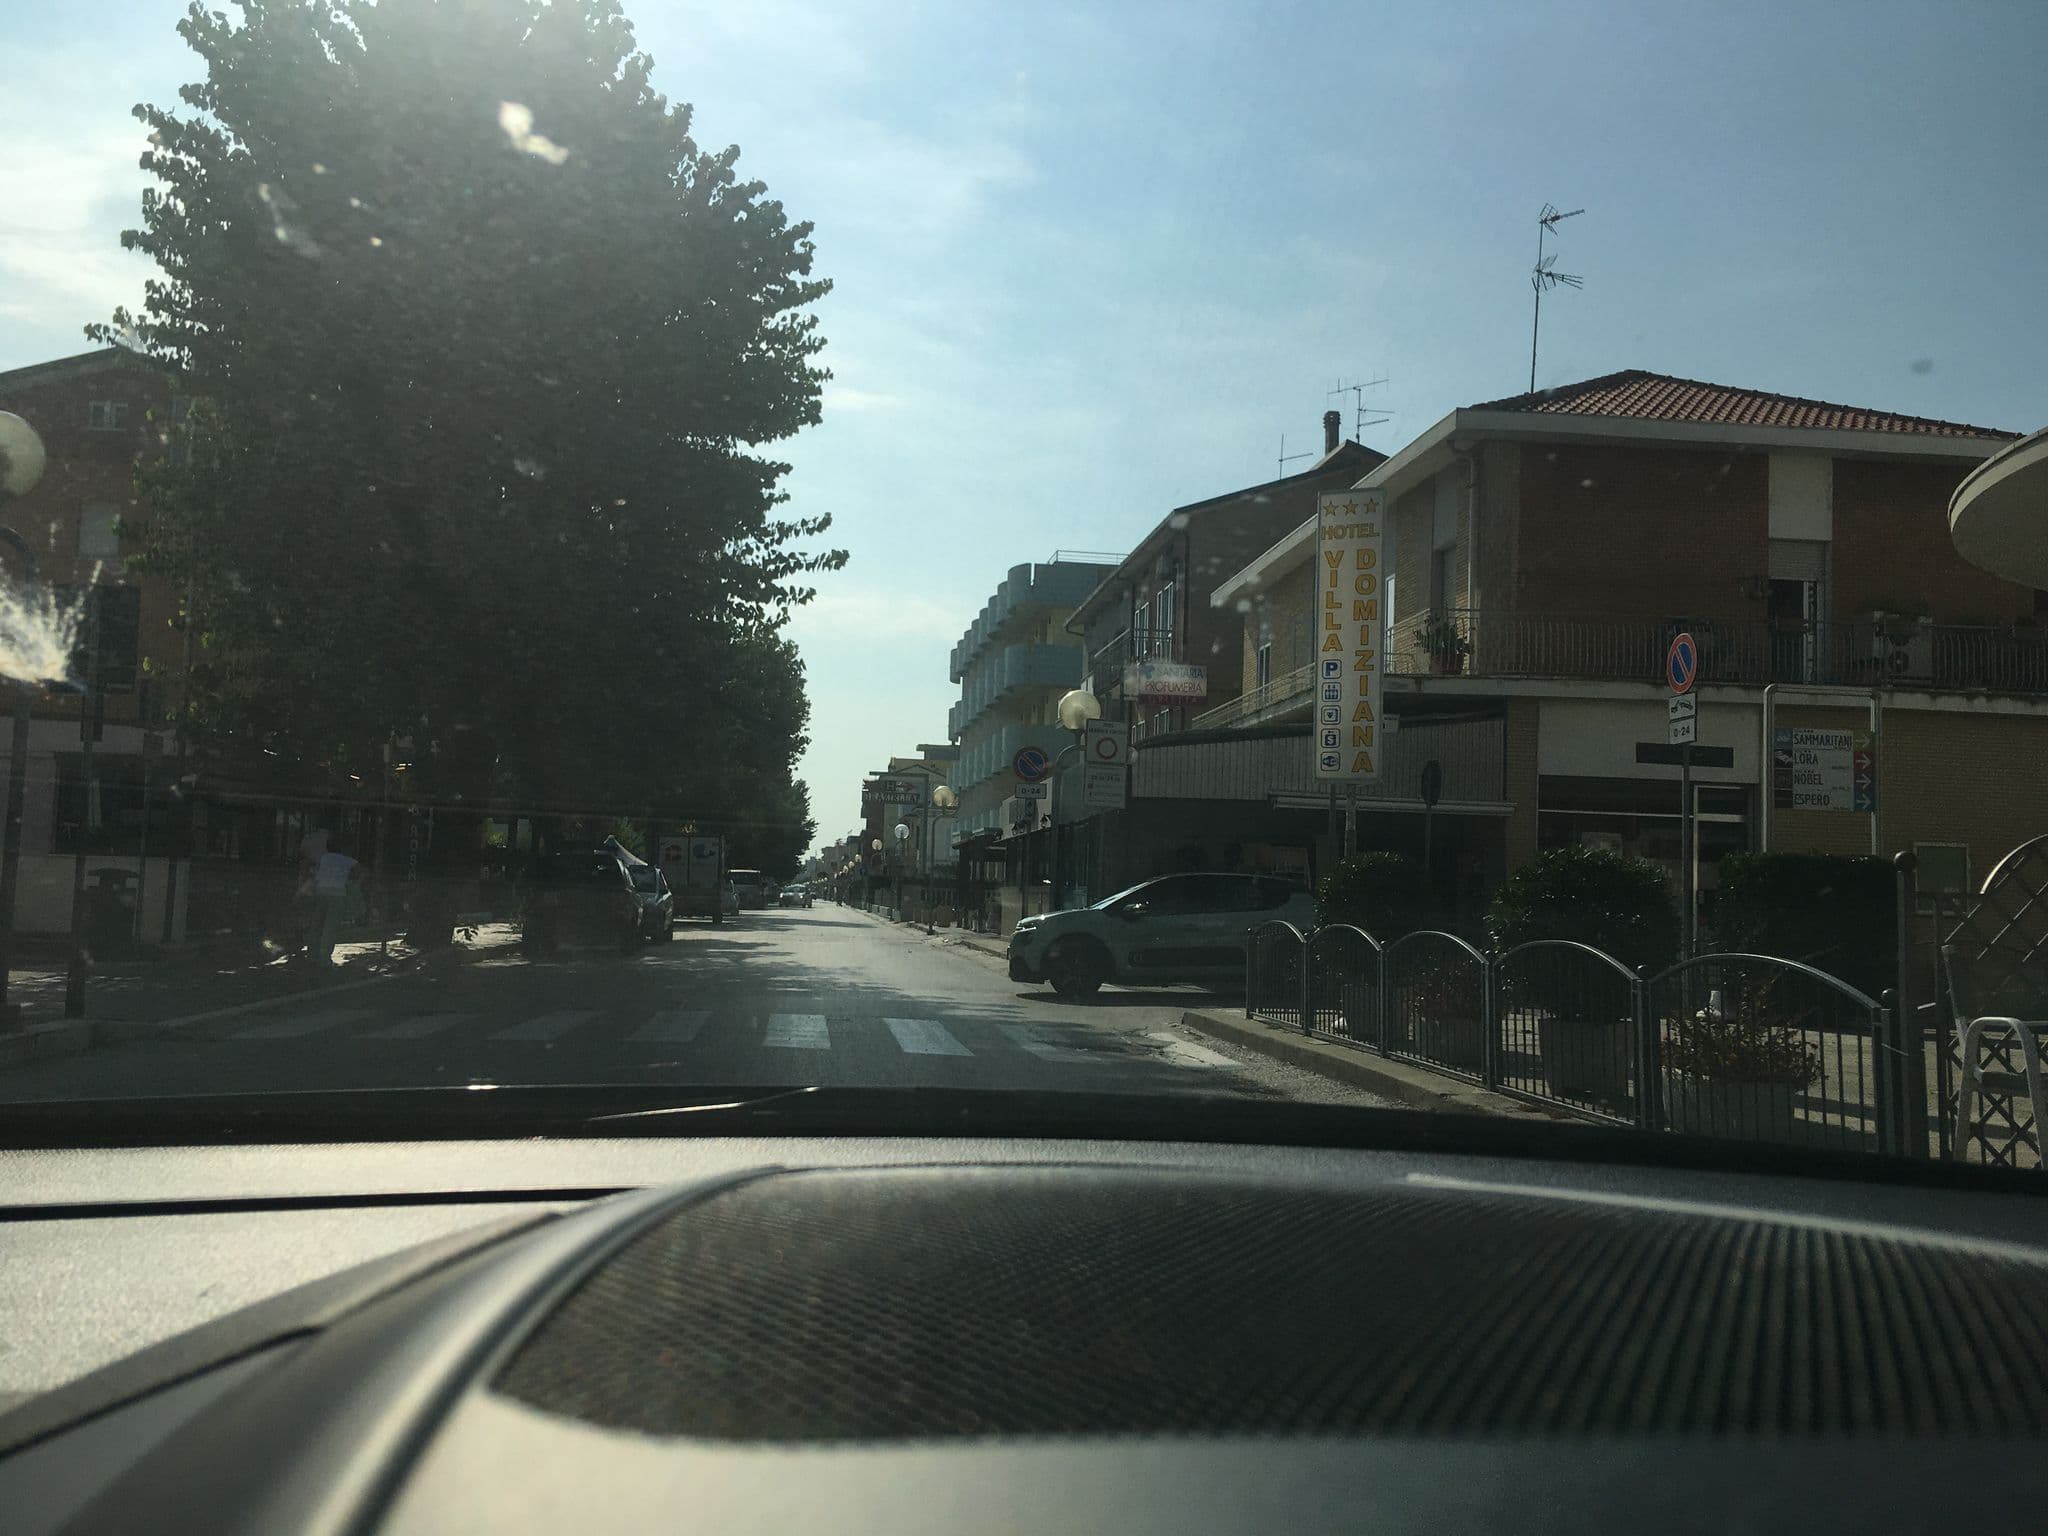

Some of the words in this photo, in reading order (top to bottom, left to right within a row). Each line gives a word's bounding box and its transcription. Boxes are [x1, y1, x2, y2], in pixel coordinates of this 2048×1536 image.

[1321, 523, 1380, 540] HOTEL
[1322, 550, 1345, 652] VILLA
[1351, 548, 1378, 772] DOMIZIANA
[1144, 681, 1203, 693] PROFUMERIA
[1793, 733, 1853, 747] SAMMARITANI
[1793, 753, 1819, 765] LORA
[1793, 773, 1824, 786] NOBEL
[1794, 794, 1831, 806] ESPERO
